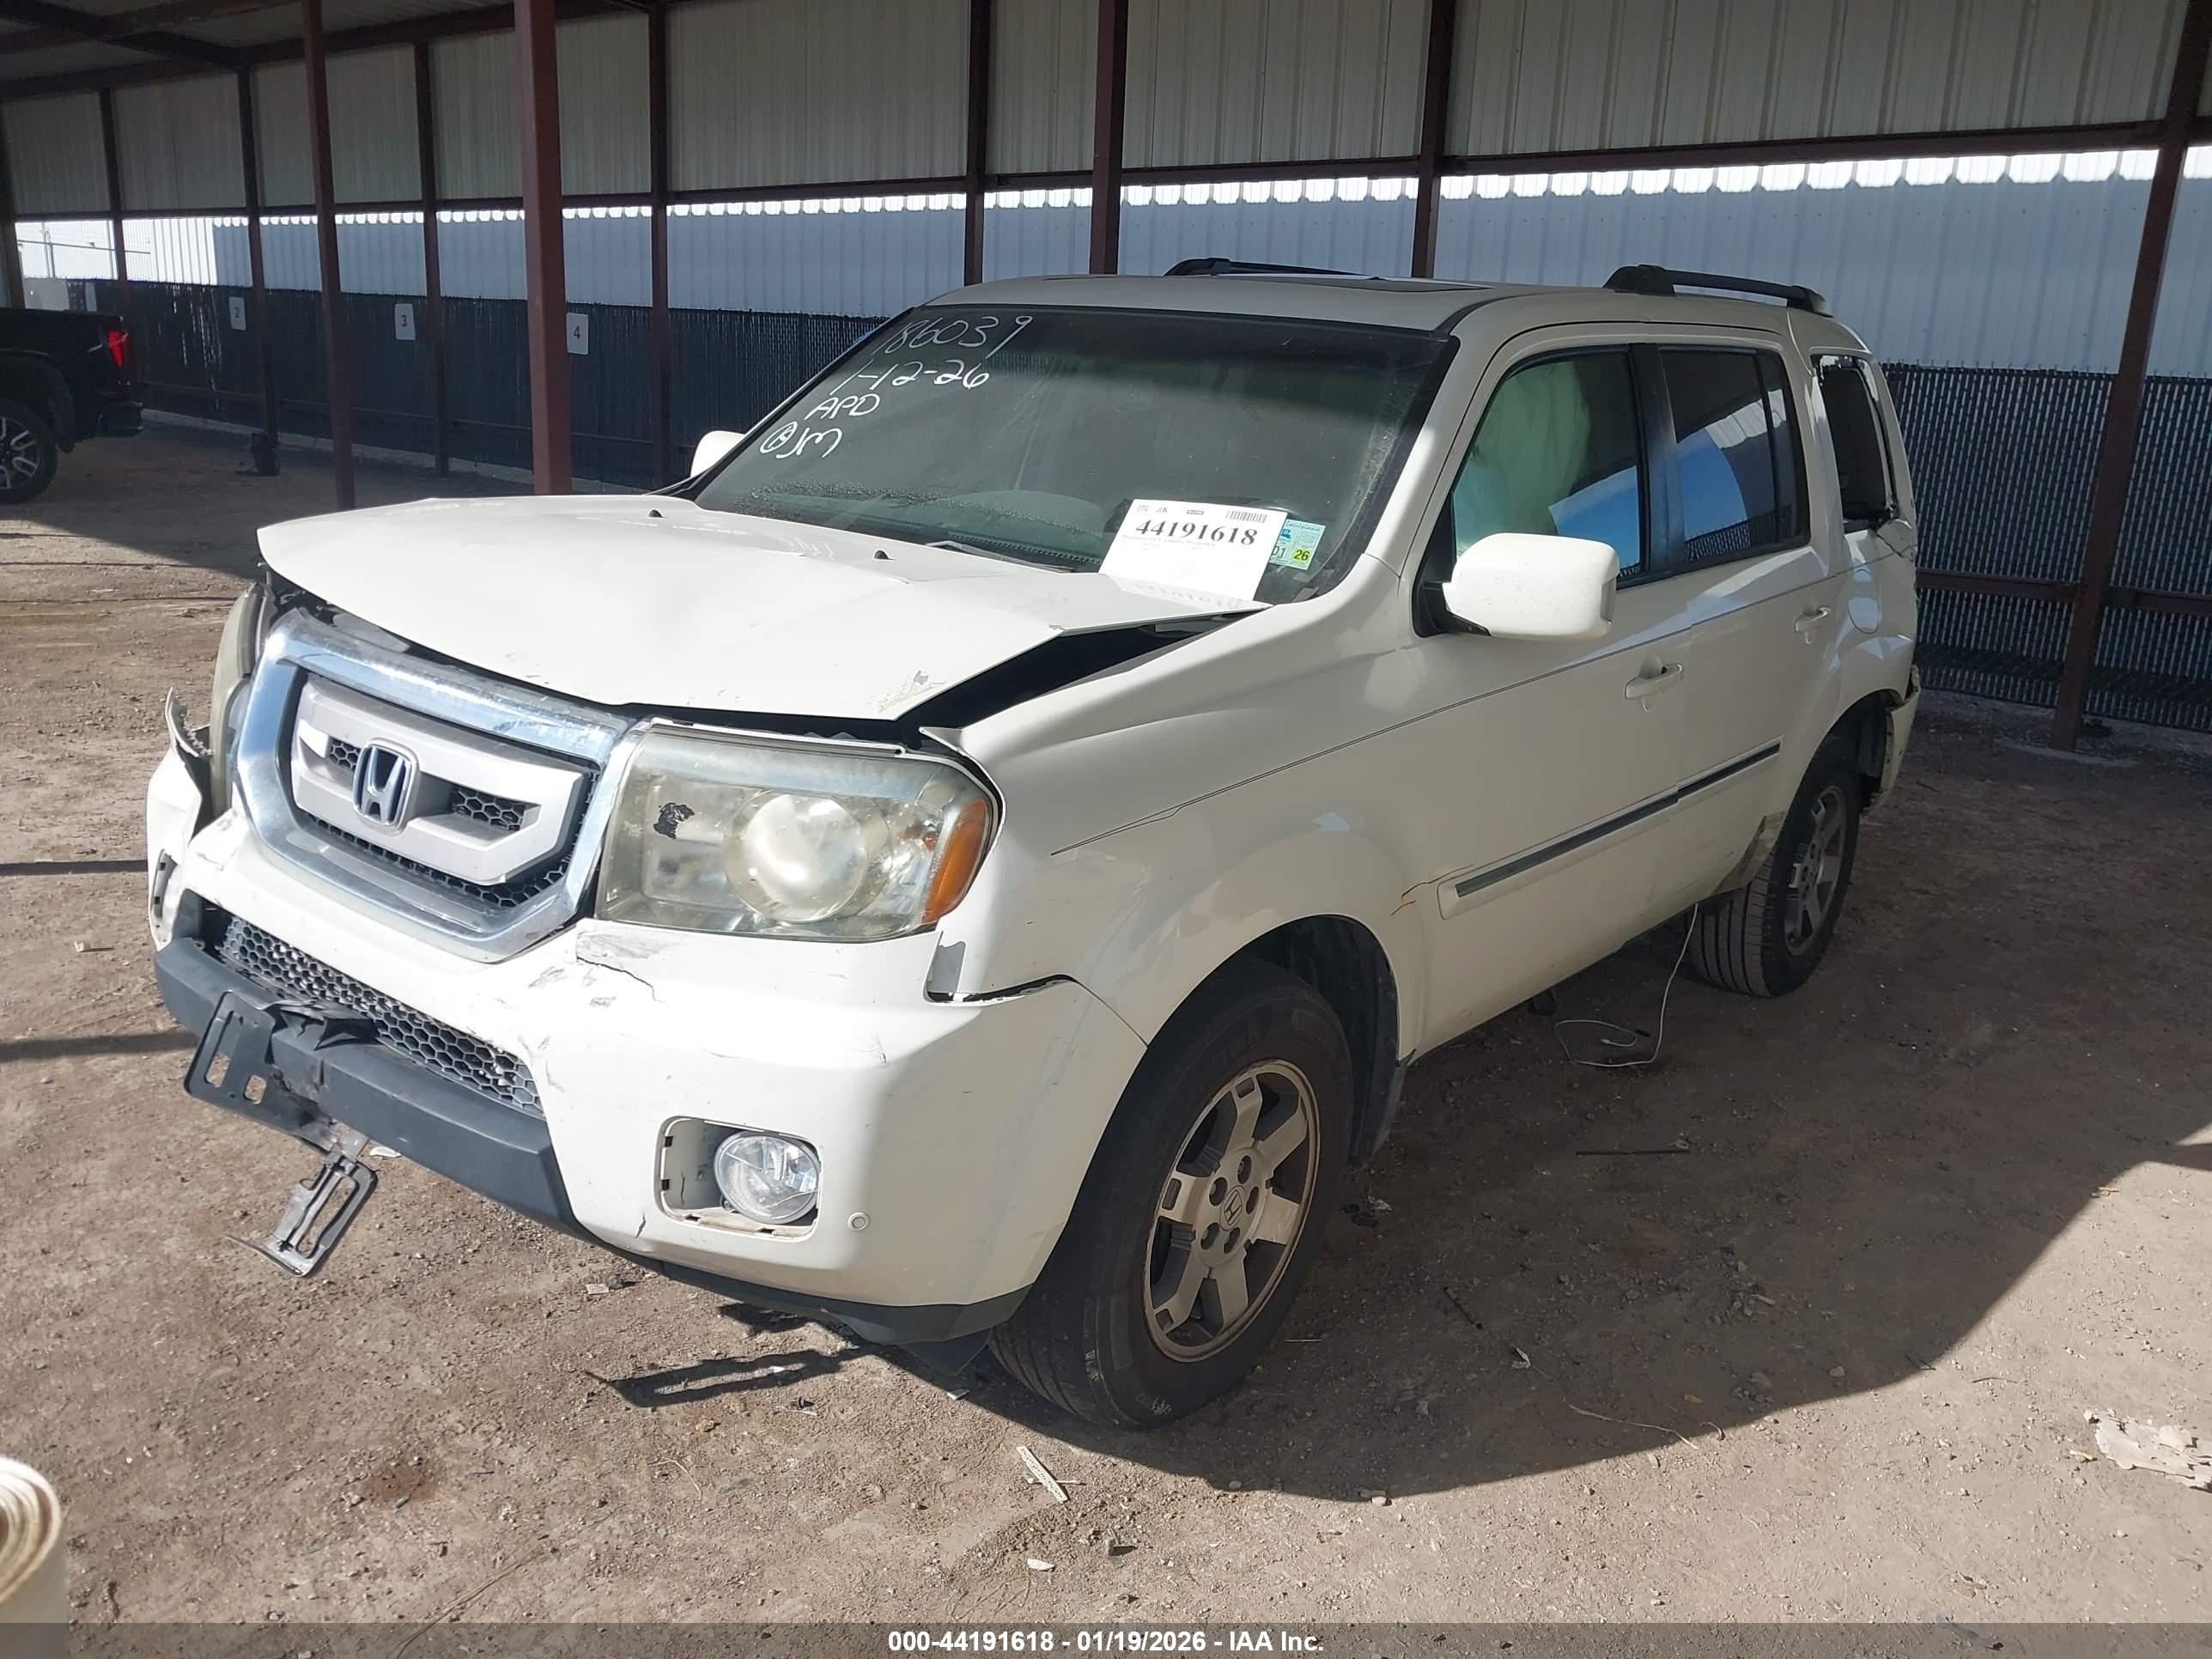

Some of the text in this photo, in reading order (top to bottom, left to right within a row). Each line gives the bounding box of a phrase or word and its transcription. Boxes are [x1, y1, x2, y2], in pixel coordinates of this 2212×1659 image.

[234, 307, 240, 318] 2
[401, 314, 408, 327] 3
[573, 325, 581, 340] 4
[829, 359, 990, 396] 1-12-26
[804, 393, 880, 421] APD
[1135, 520, 1258, 546] 44191618
[1293, 549, 1310, 562] 26
